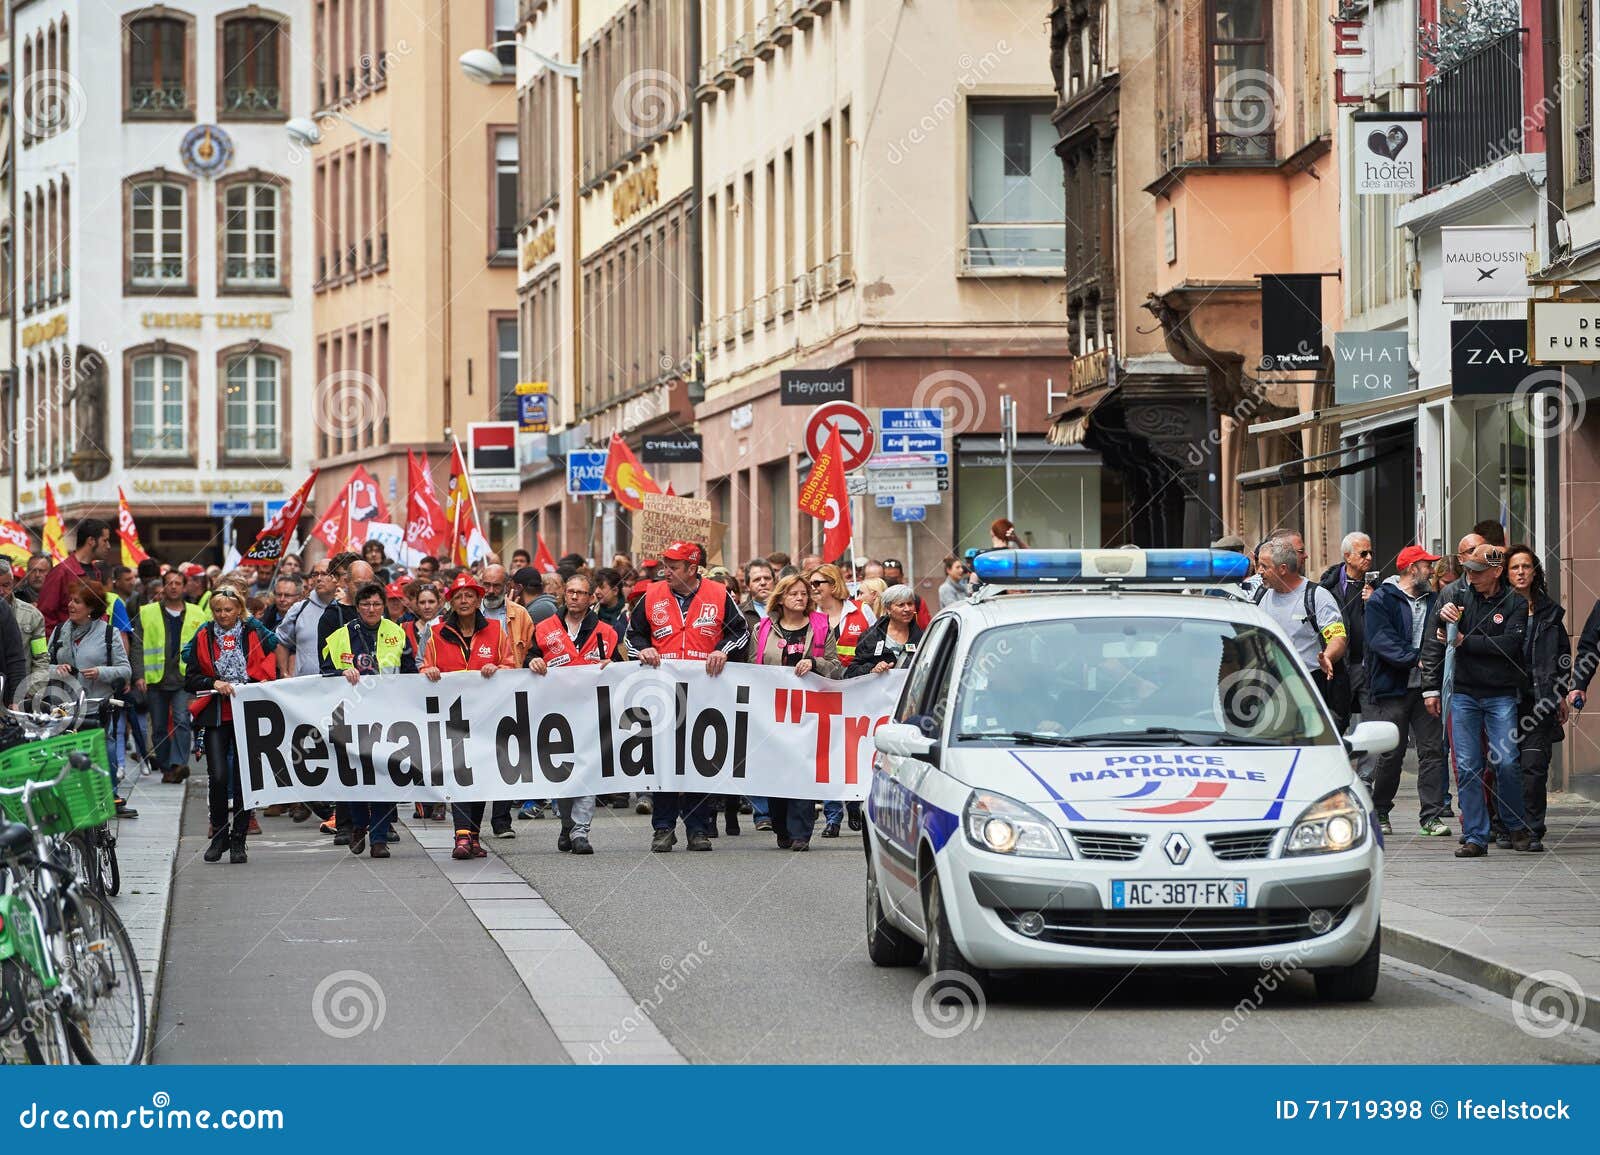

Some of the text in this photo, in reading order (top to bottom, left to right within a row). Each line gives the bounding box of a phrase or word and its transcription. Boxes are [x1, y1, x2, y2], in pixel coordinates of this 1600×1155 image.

[1361, 179, 1416, 191] des anges
[1550, 336, 1600, 348] FURS
[1276, 354, 1291, 362] The
[1340, 347, 1404, 361] WHAT
[788, 379, 845, 396] Heyraud
[1352, 374, 1392, 389] FOR
[646, 441, 699, 449] CYRILLUS
[572, 466, 605, 480] TAXIS
[223, 639, 235, 648] cgt
[384, 635, 399, 646] cgt
[243, 696, 473, 793] Retrait
[496, 691, 575, 784] de
[596, 685, 655, 778] la
[675, 682, 750, 778] loi
[1105, 755, 1225, 766] POLICE
[1069, 767, 1267, 782] NATIONALE
